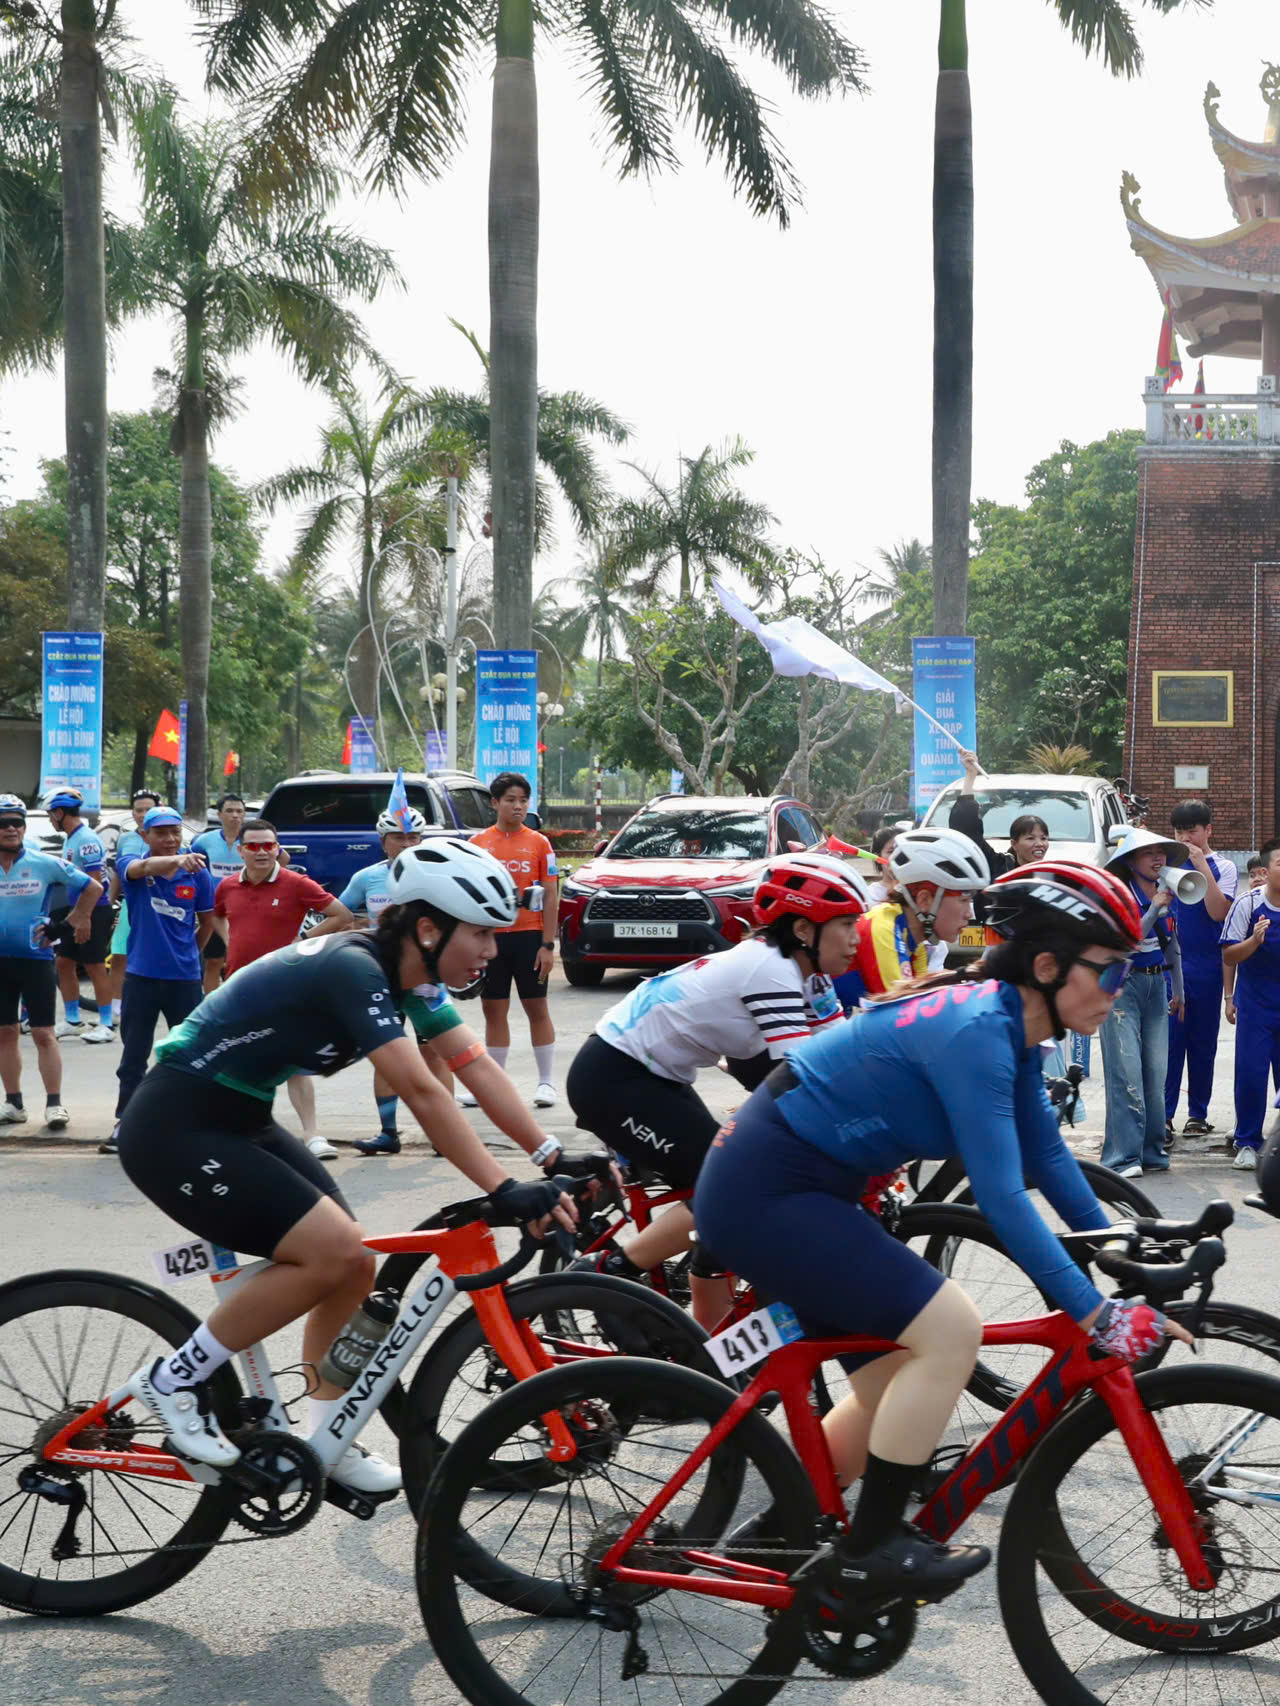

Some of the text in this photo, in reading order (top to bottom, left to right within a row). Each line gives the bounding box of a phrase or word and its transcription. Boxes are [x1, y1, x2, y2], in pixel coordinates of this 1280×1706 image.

[48, 681, 70, 703] CHÀO
[936, 688, 956, 704] GIẢI
[482, 700, 532, 721] CHÀO MỪNG
[936, 707, 956, 719] ĐUA
[1028, 884, 1097, 921] HJC
[165, 1243, 208, 1279] 425
[328, 1275, 443, 1440] PINARELLO
[721, 1319, 769, 1363] 413
[930, 1350, 1075, 1535] IANT
